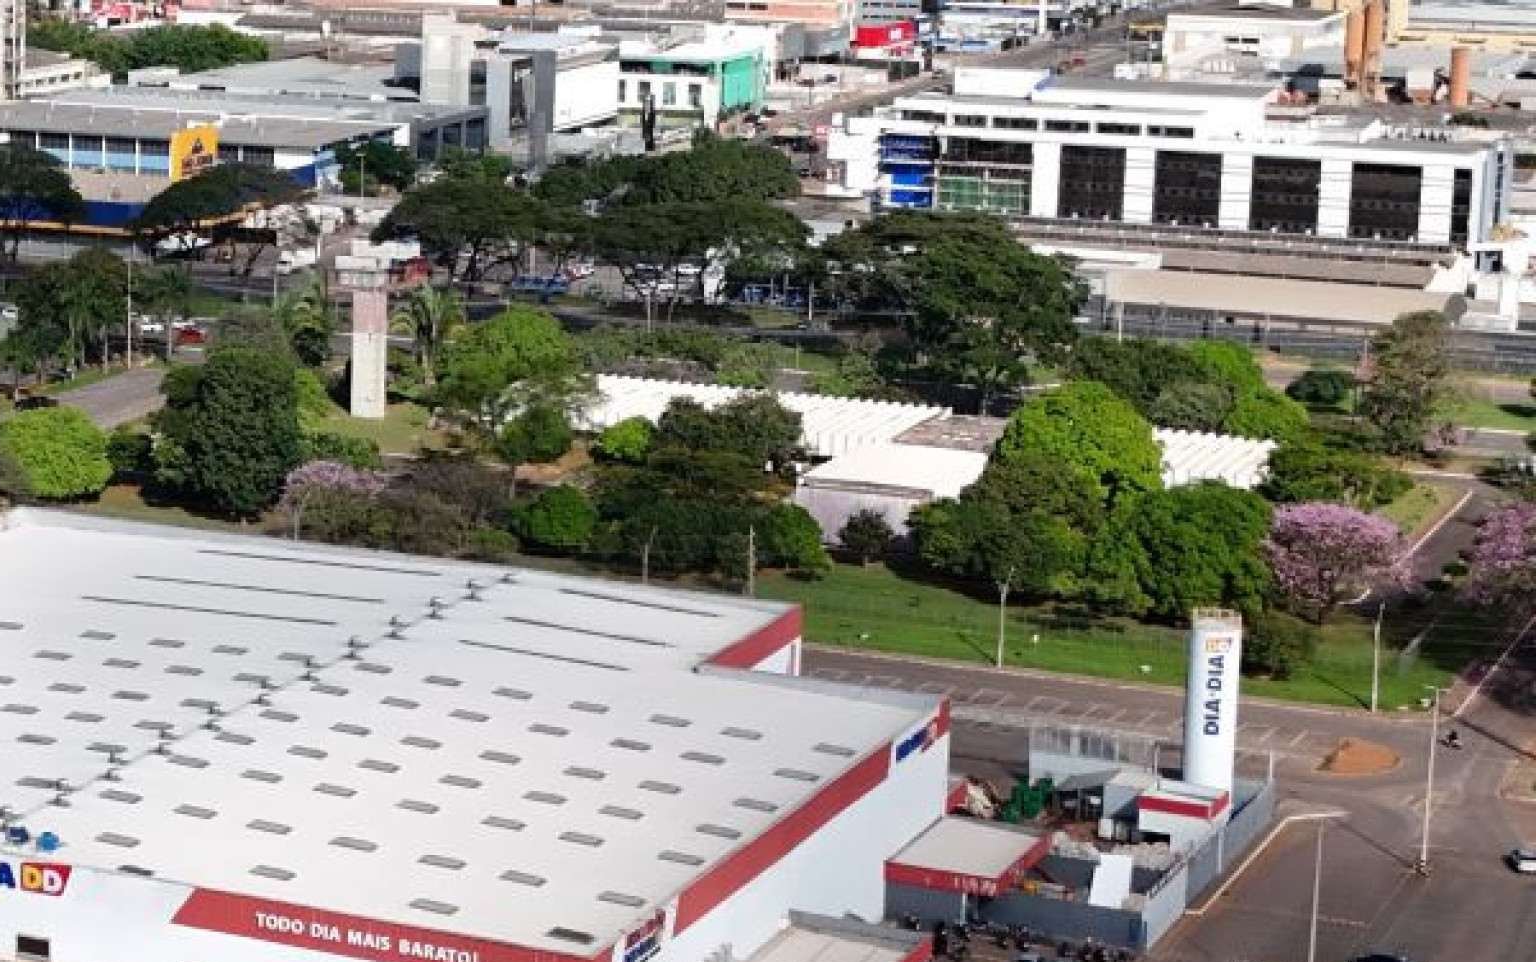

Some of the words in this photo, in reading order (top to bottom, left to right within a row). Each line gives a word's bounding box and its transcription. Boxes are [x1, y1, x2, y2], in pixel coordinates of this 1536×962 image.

[255, 912, 304, 935] TODO
[310, 922, 341, 942] DIA
[347, 928, 392, 951] MAIS
